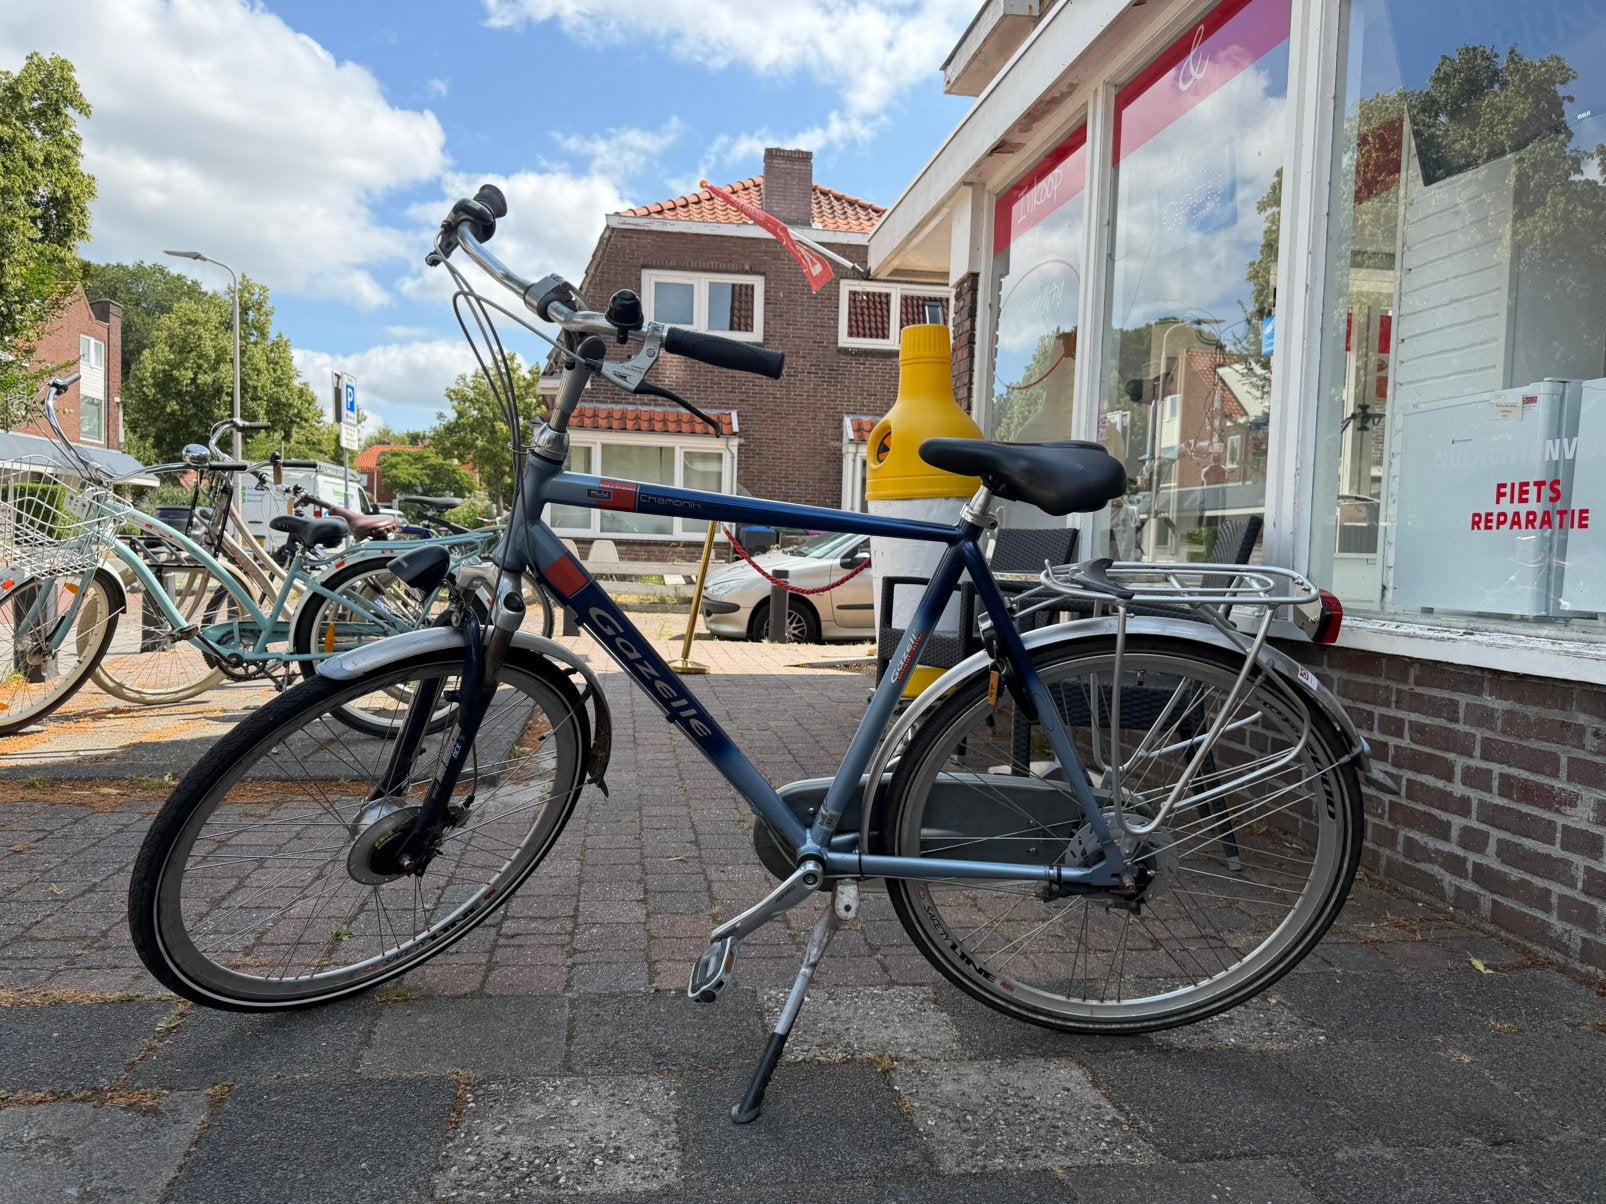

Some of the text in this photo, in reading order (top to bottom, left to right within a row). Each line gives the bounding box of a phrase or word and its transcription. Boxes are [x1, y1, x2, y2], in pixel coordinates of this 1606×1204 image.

[1178, 24, 1210, 92] &
[1495, 479, 1562, 505] FIETS
[1471, 508, 1590, 531] REPARATIE
[589, 607, 712, 737] Gazelle
[923, 904, 951, 941] SAFETY
